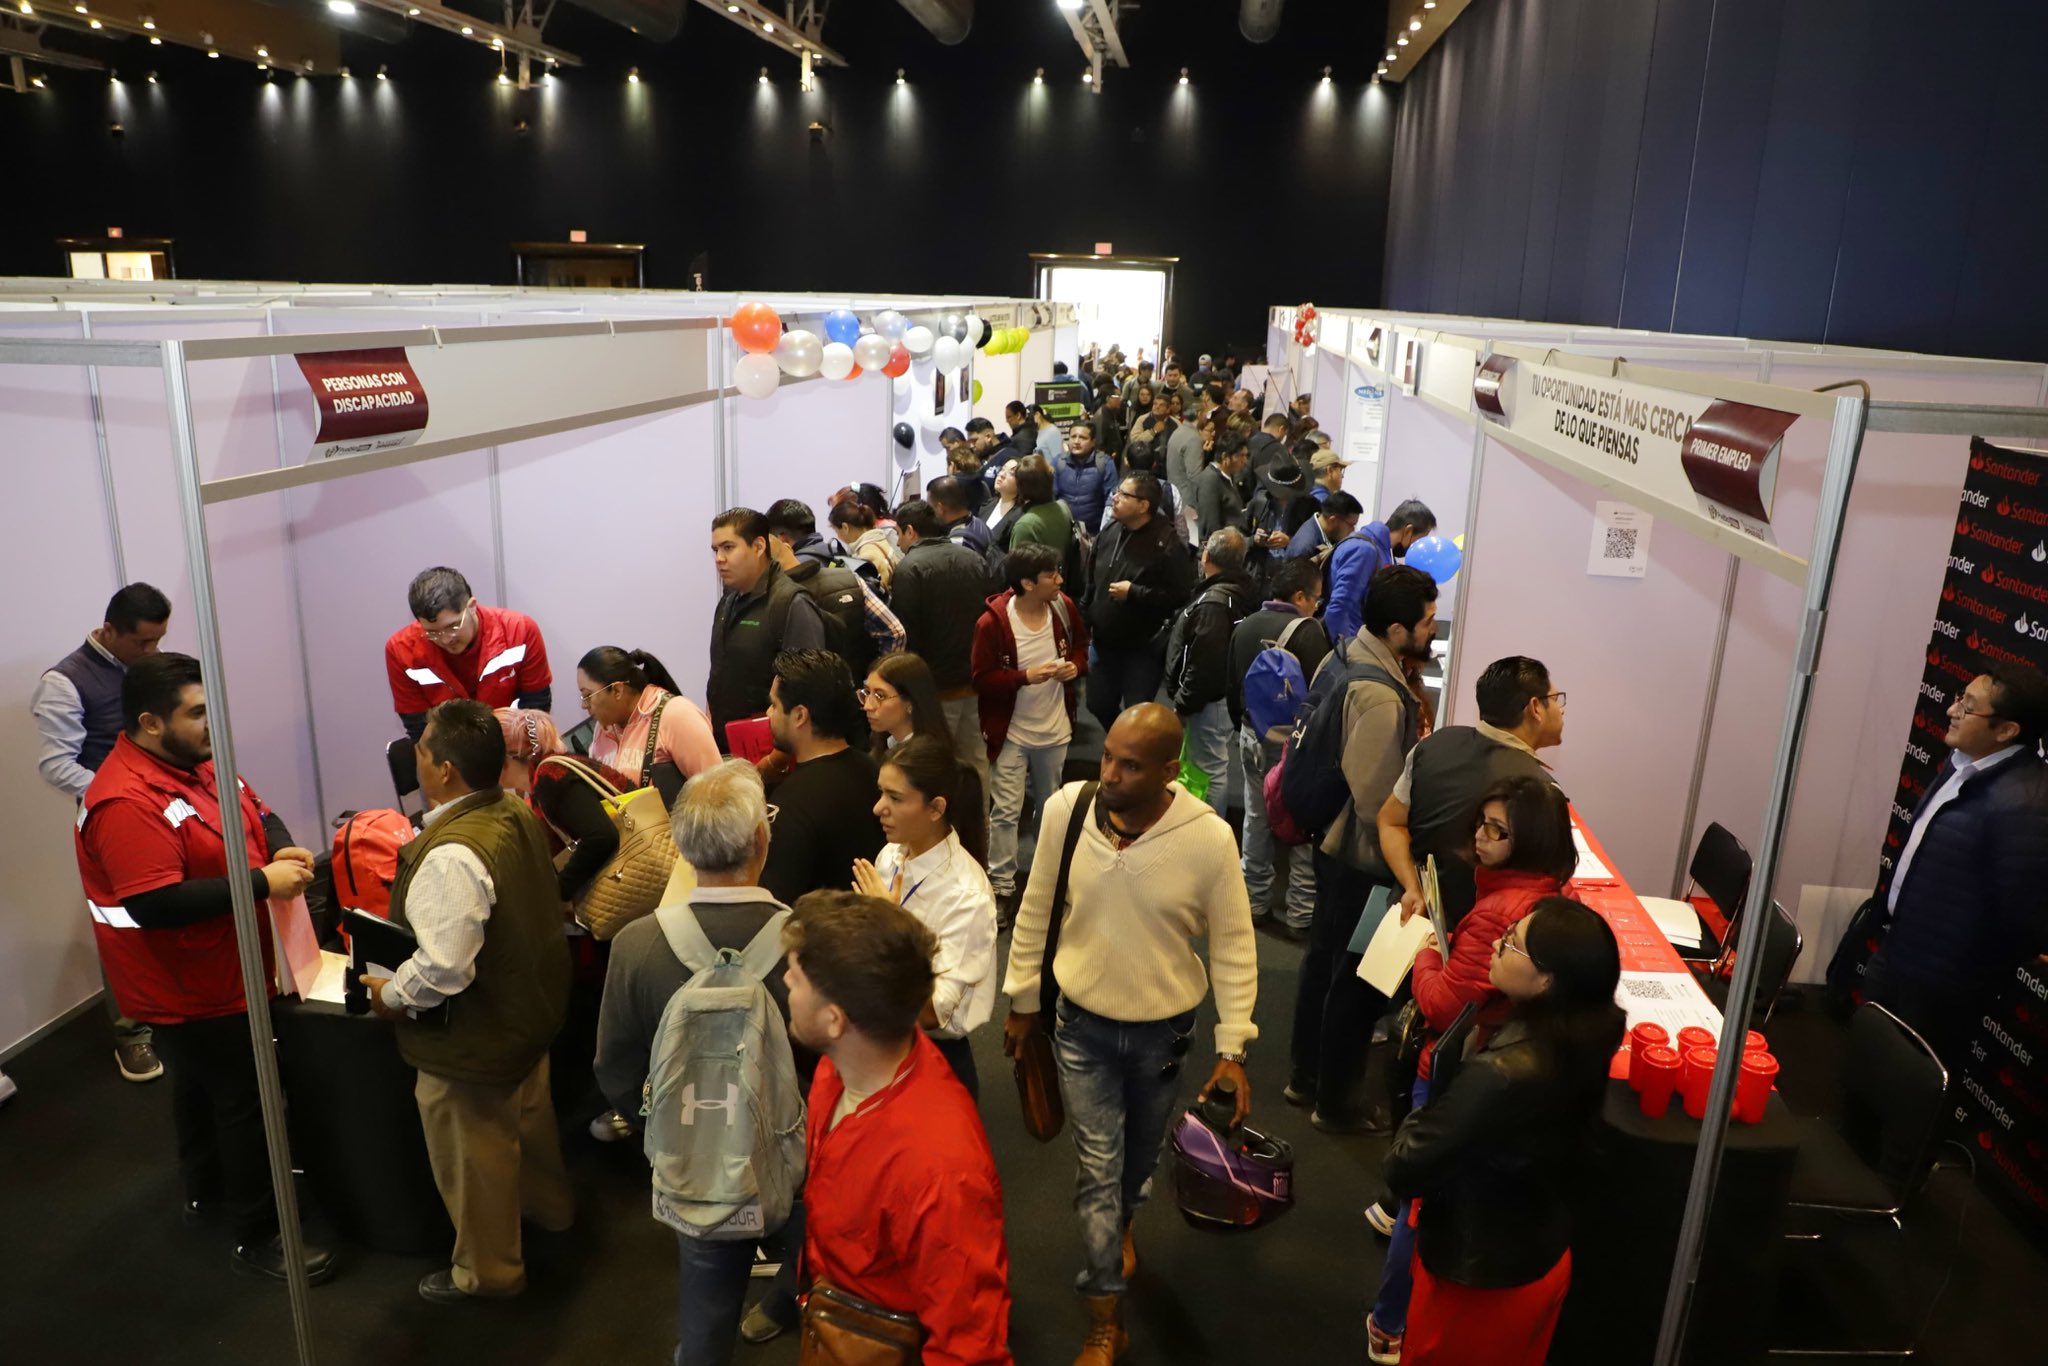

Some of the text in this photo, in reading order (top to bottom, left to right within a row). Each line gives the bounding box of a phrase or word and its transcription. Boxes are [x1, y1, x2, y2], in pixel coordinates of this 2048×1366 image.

[322, 371, 408, 392] PERSONAS CON
[333, 391, 415, 413] DISCAPACIDAD
[1532, 374, 1541, 396] TU
[1541, 376, 1597, 413] OPORTUNIDAD
[1598, 388, 1622, 423] ESTÁ
[1623, 398, 1648, 431] MAS
[1554, 409, 1639, 465] DE LO QUE PIENSAS
[1690, 438, 1751, 471] PRIMER EMPLEO
[1984, 457, 2041, 486] Santander
[1970, 522, 2024, 555] Santander
[1956, 590, 2007, 625] Santander
